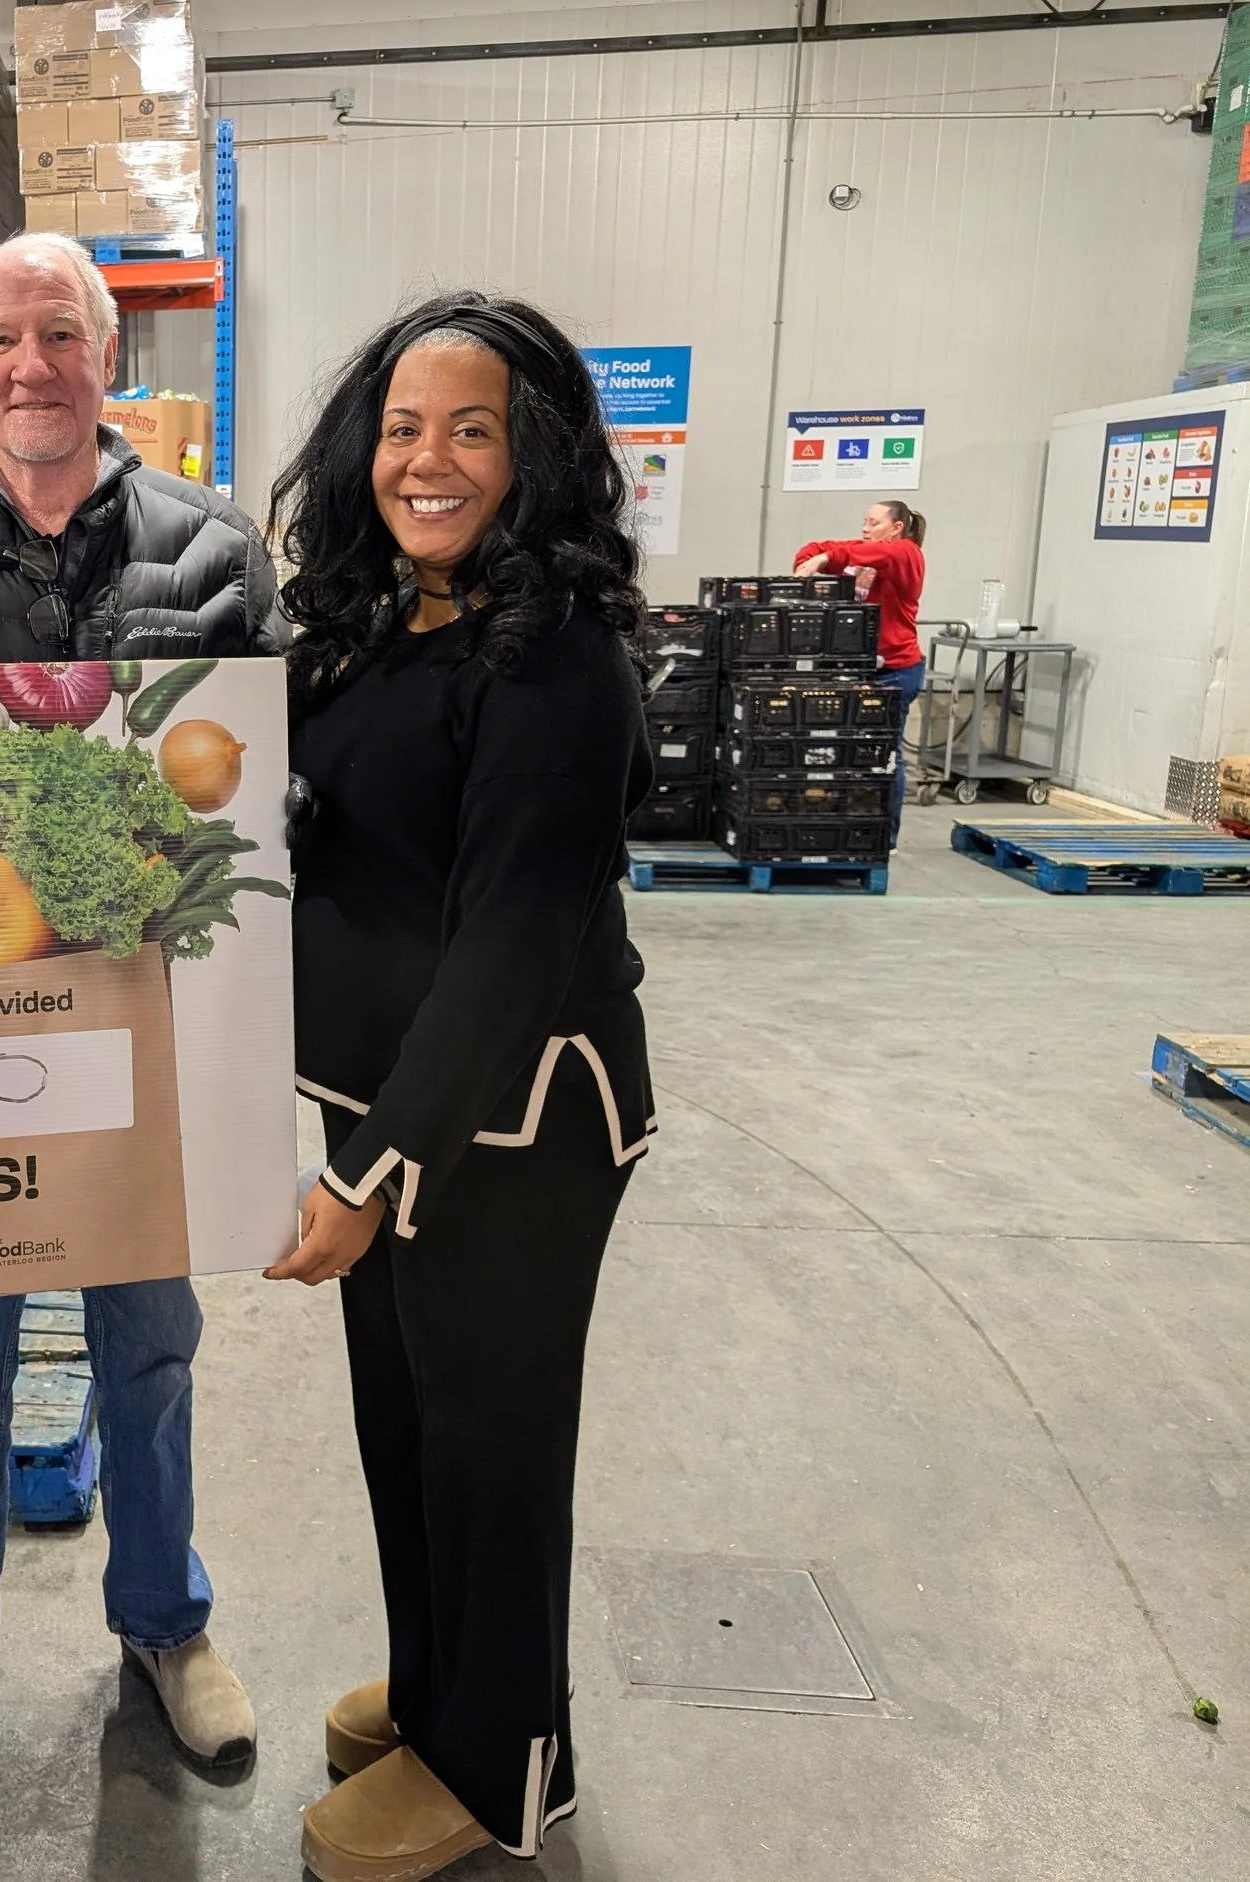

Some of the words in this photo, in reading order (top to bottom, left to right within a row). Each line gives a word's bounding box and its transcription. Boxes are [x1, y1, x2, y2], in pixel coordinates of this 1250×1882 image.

[611, 358, 651, 373] Food
[609, 375, 676, 389] Network
[795, 415, 839, 425] Warehouse
[839, 414, 860, 423] work
[861, 415, 886, 423] zones
[124, 626, 162, 643] Eddie
[162, 626, 202, 638] Bauer
[36, 1254, 67, 1264] REGION
